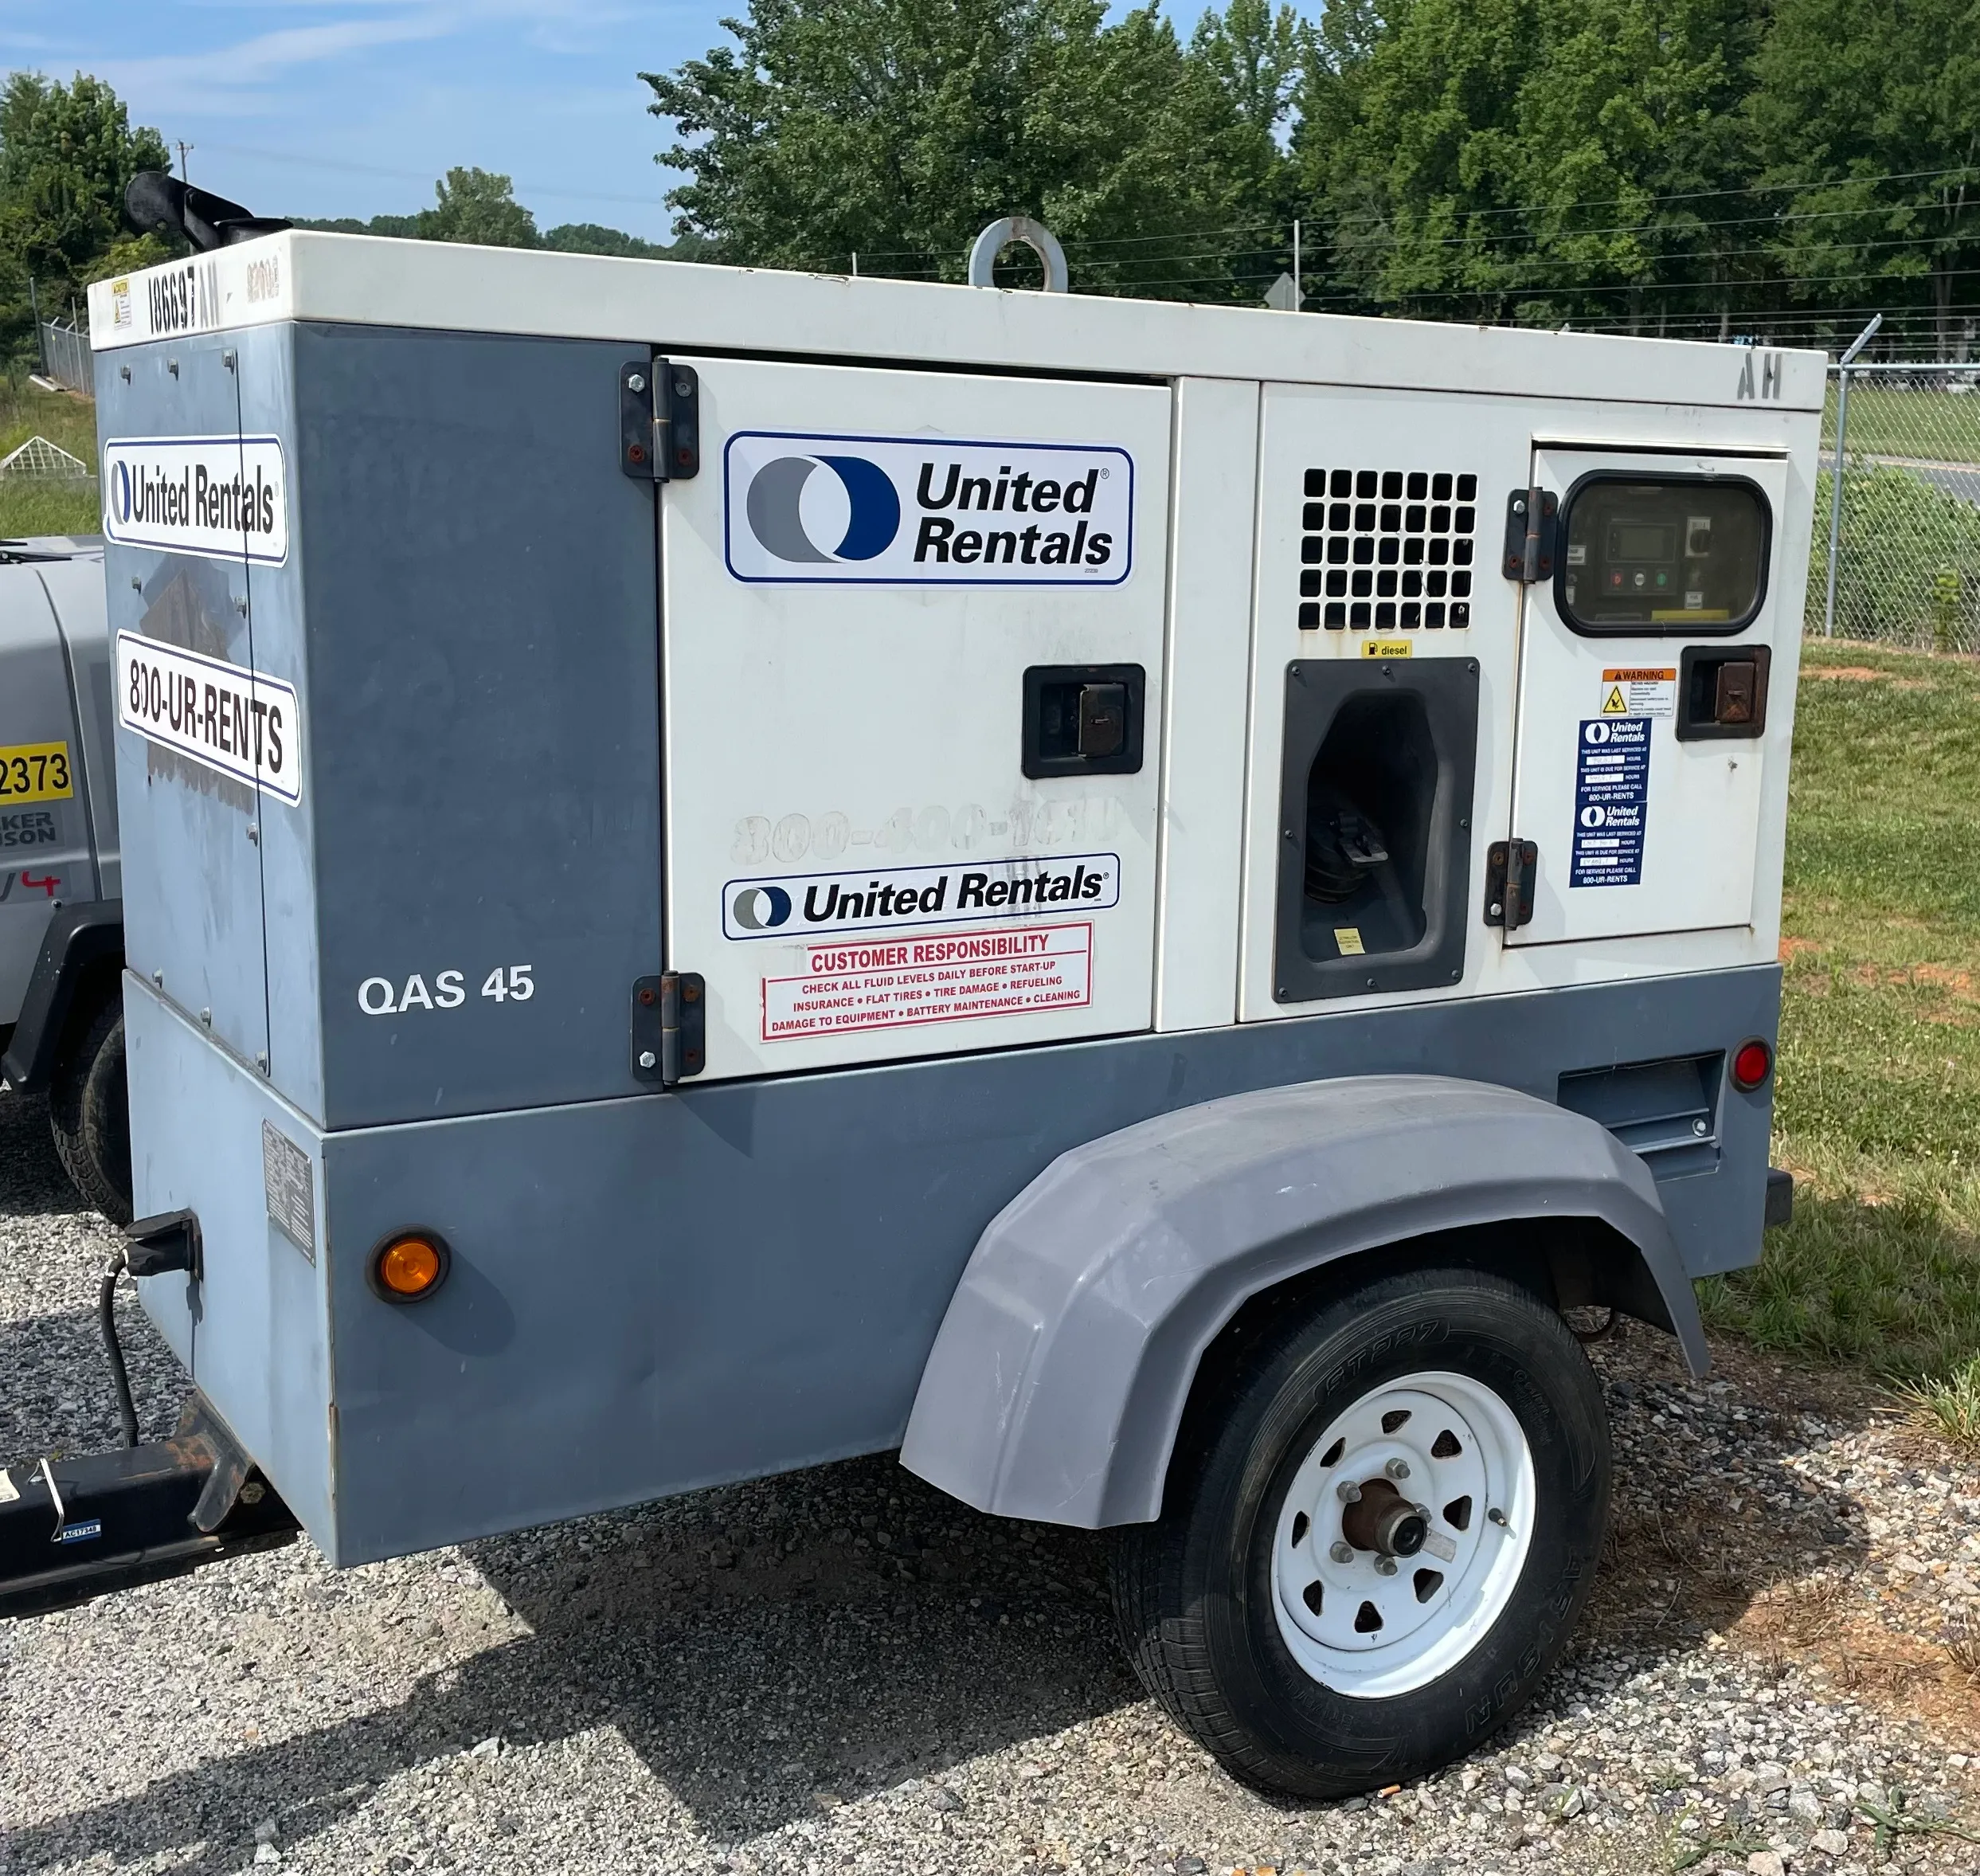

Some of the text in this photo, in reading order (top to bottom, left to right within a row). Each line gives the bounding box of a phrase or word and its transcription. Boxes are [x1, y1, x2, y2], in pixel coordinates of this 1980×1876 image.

[131, 464, 274, 535] United Rentals
[915, 462, 1101, 514] United
[913, 516, 1113, 566] Rentals
[1381, 645, 1407, 656] diesel
[1622, 670, 1665, 680] WARNING
[129, 658, 283, 774] 800-UR-RENTS
[1610, 721, 1644, 732] United
[1610, 731, 1645, 742] Rentals
[0, 754, 69, 794] 2373
[1588, 792, 1634, 801] 800-UR-RENTS
[1606, 805, 1639, 817] United
[0, 812, 54, 831] KER
[0, 827, 57, 847] SON
[1605, 816, 1641, 827] Rentals
[802, 864, 1102, 922] United Rentals
[1583, 875, 1628, 884] 800-UR-RENTS
[811, 934, 1050, 973] CUSTOMER RESPONSIBILITY
[358, 964, 534, 1016] QAS 45
[793, 976, 1062, 1012] INSURANCE FLAT TIRES TIRE DAMAGE REFUELING
[801, 961, 1056, 995] CHECK ALL FLUID LEVELS DAILY BEFORE START-UP
[772, 989, 1081, 1032] DAMAGE TO EQUIPMENT BATTERY MAINTENANCE CLEANING
